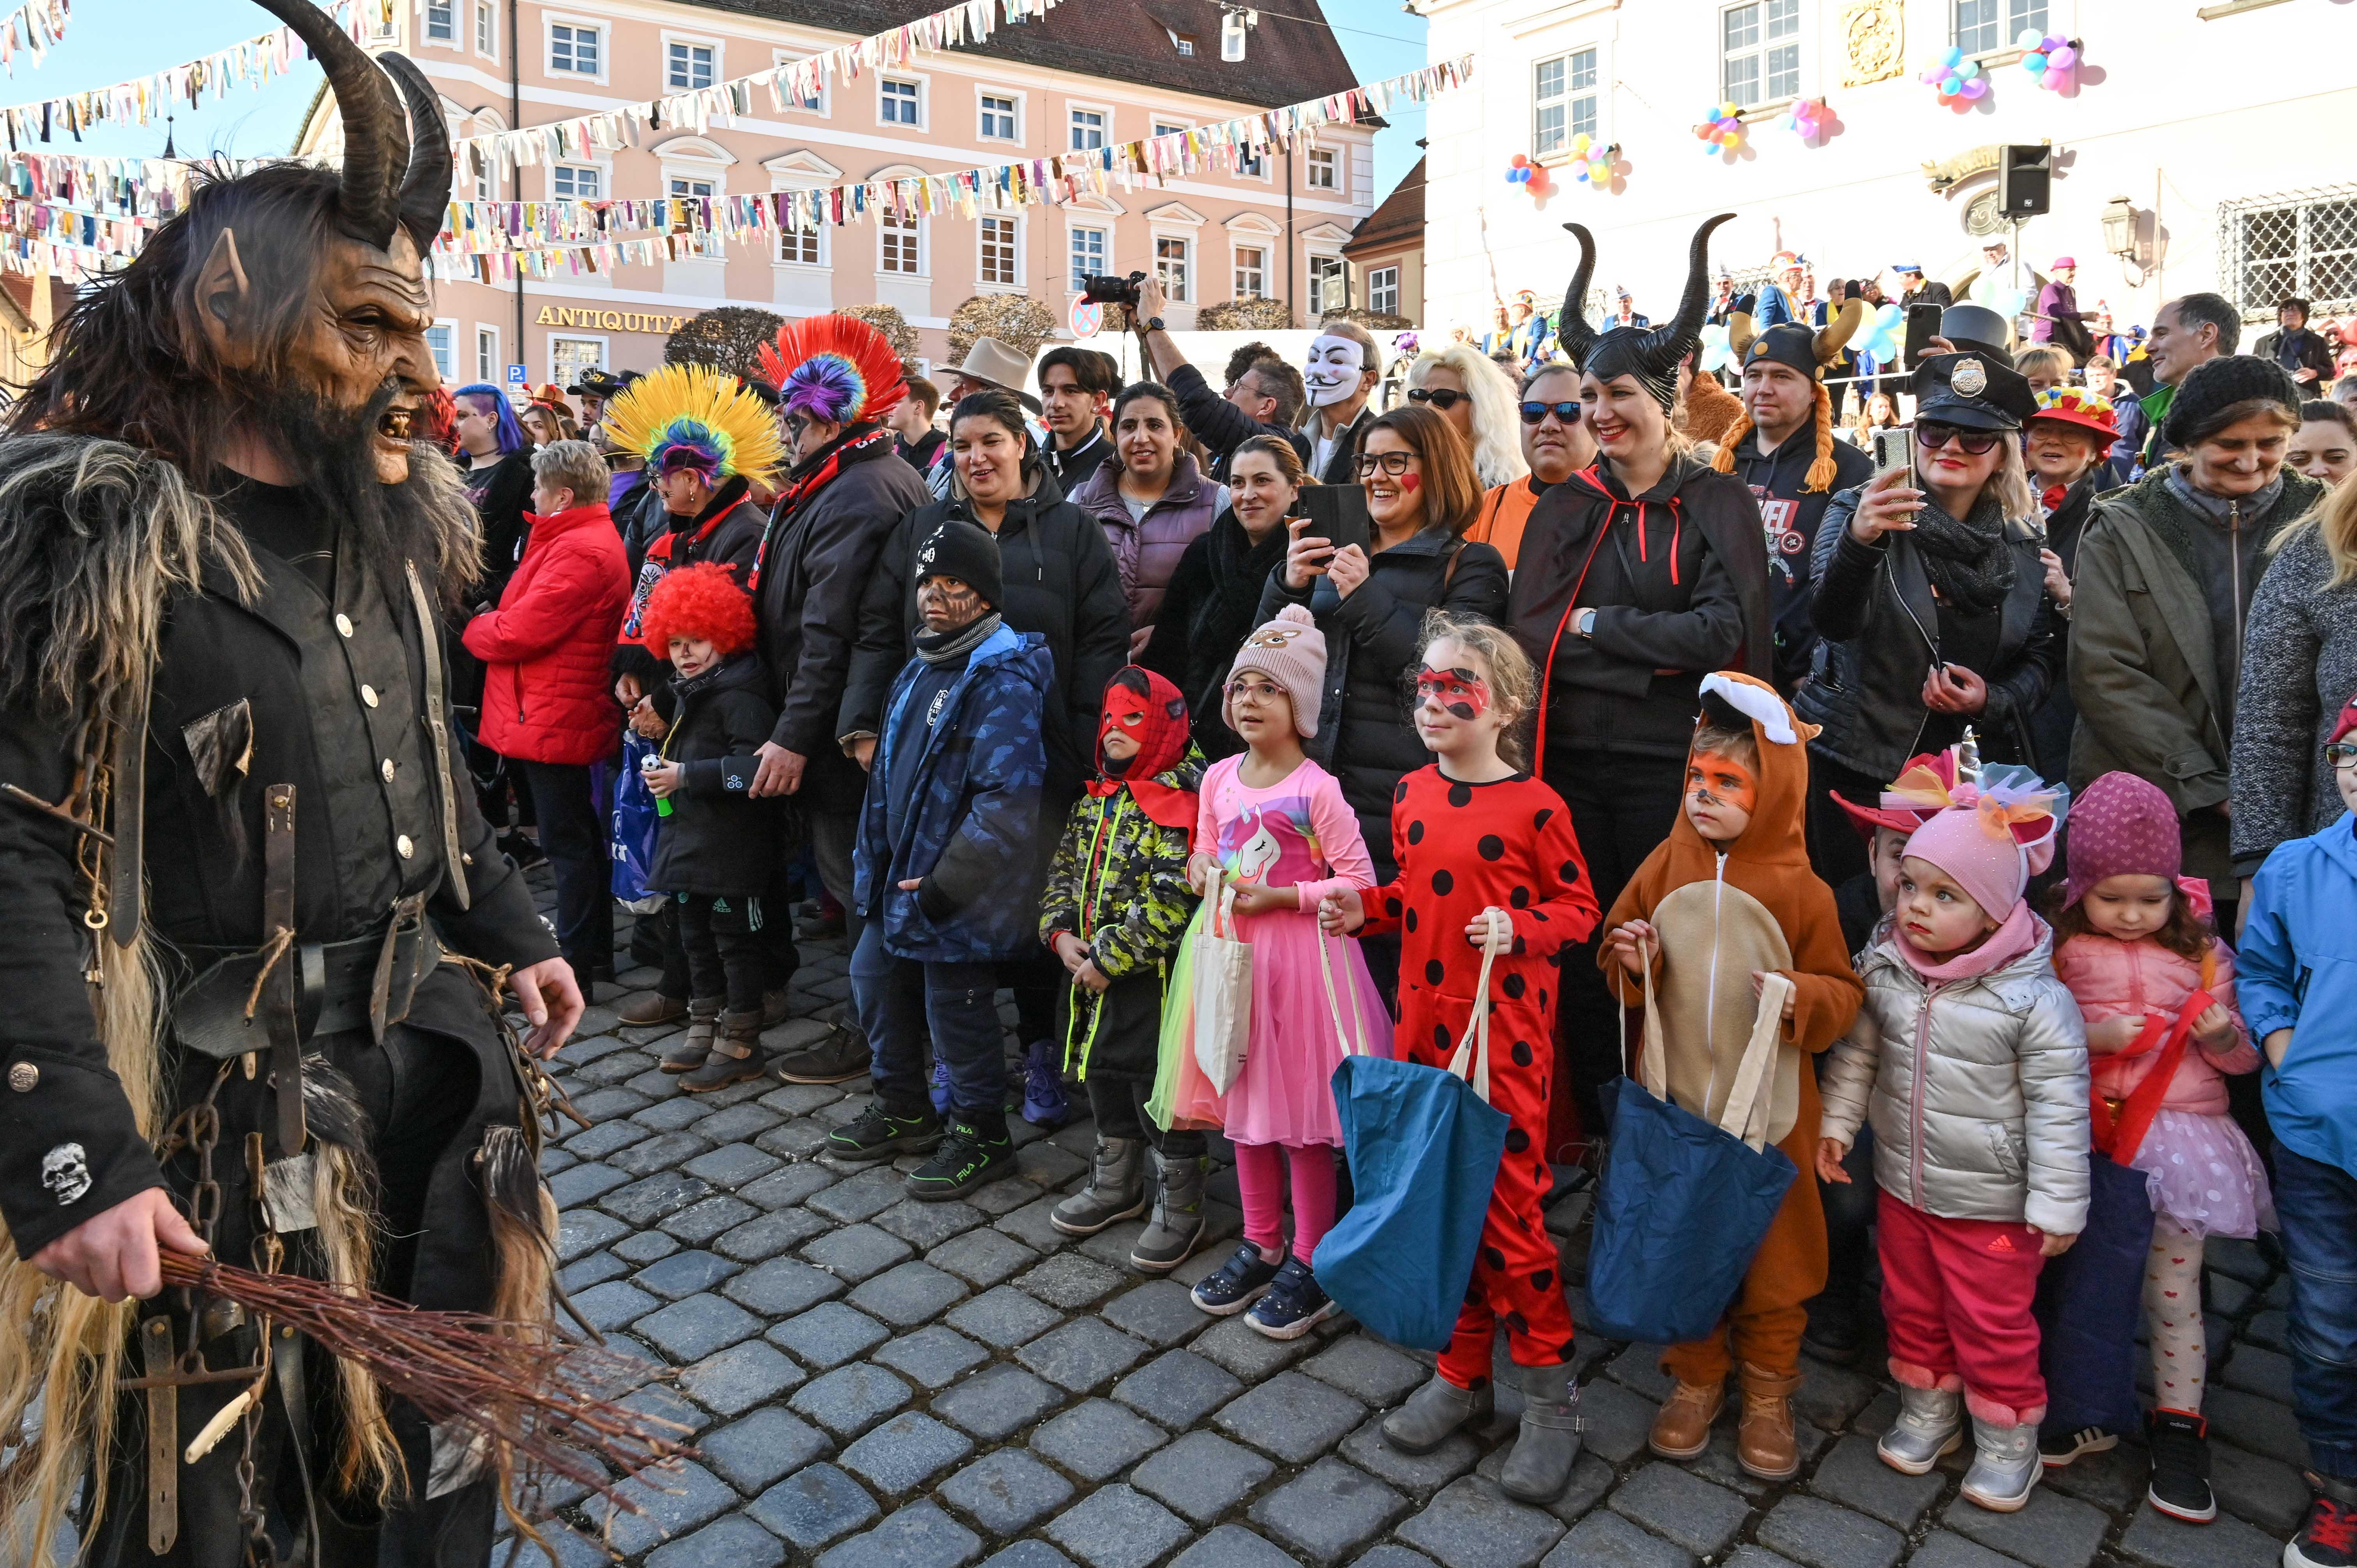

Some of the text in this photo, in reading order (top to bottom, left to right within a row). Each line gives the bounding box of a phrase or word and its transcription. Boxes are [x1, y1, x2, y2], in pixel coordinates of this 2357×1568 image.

[535, 305, 724, 337] ANTIQUITÄ
[510, 367, 521, 381] P
[956, 1125, 973, 1134] FILA
[956, 1163, 975, 1182] FILA
